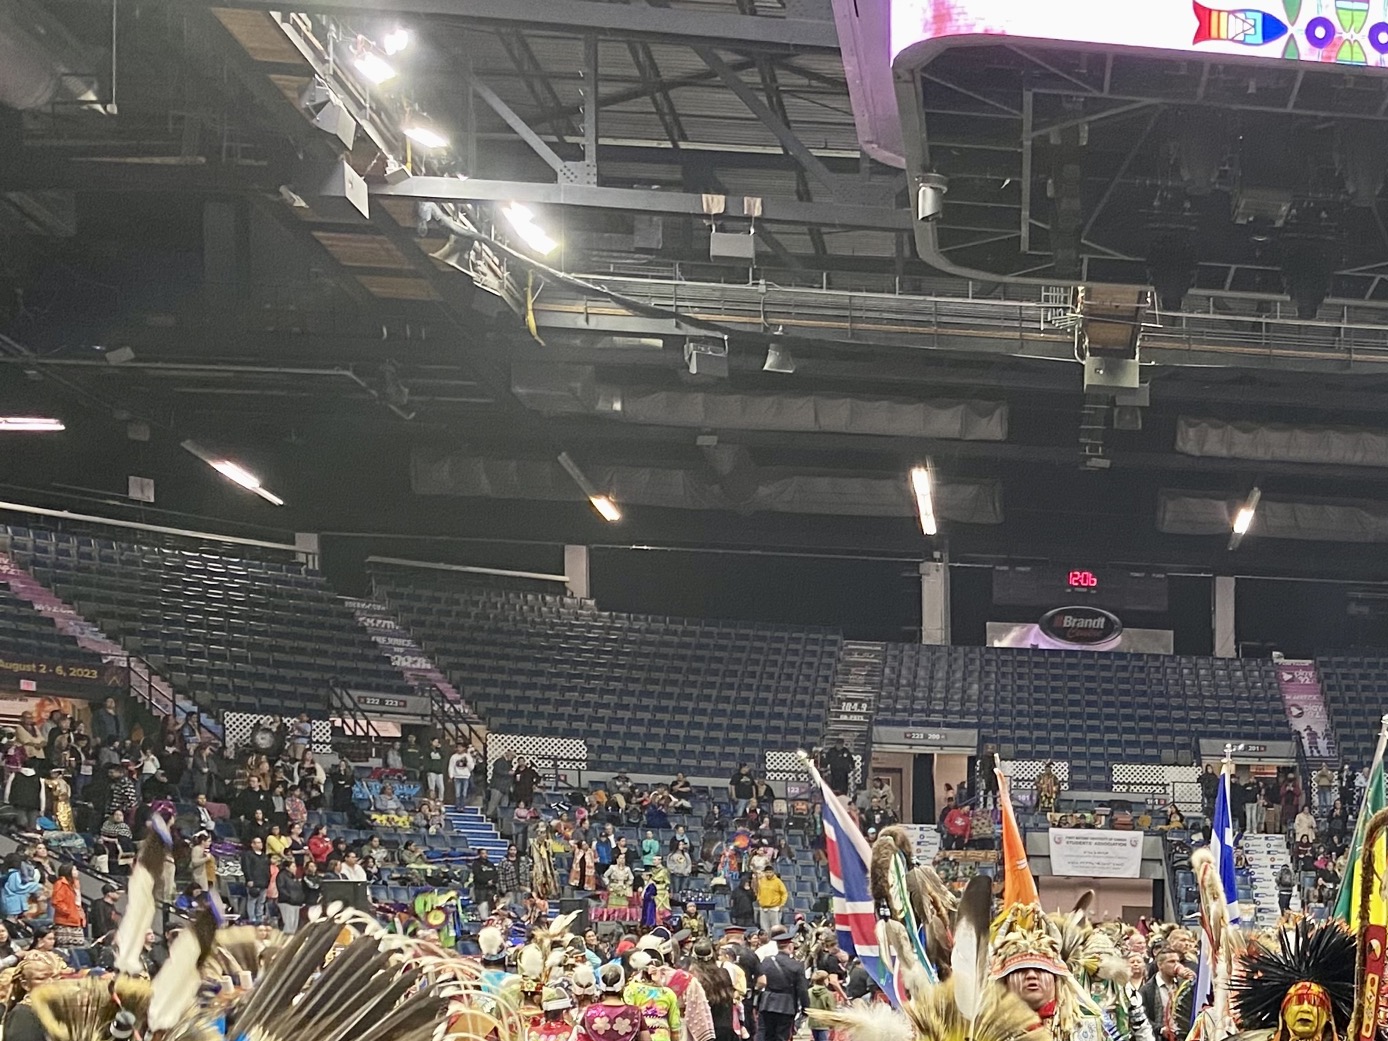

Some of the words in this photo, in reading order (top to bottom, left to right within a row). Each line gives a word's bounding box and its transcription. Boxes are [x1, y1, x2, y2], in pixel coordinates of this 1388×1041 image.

[1063, 615, 1106, 629] Brandt
[0, 659, 36, 672] August
[39, 663, 47, 674] 2
[69, 667, 98, 679] 2023
